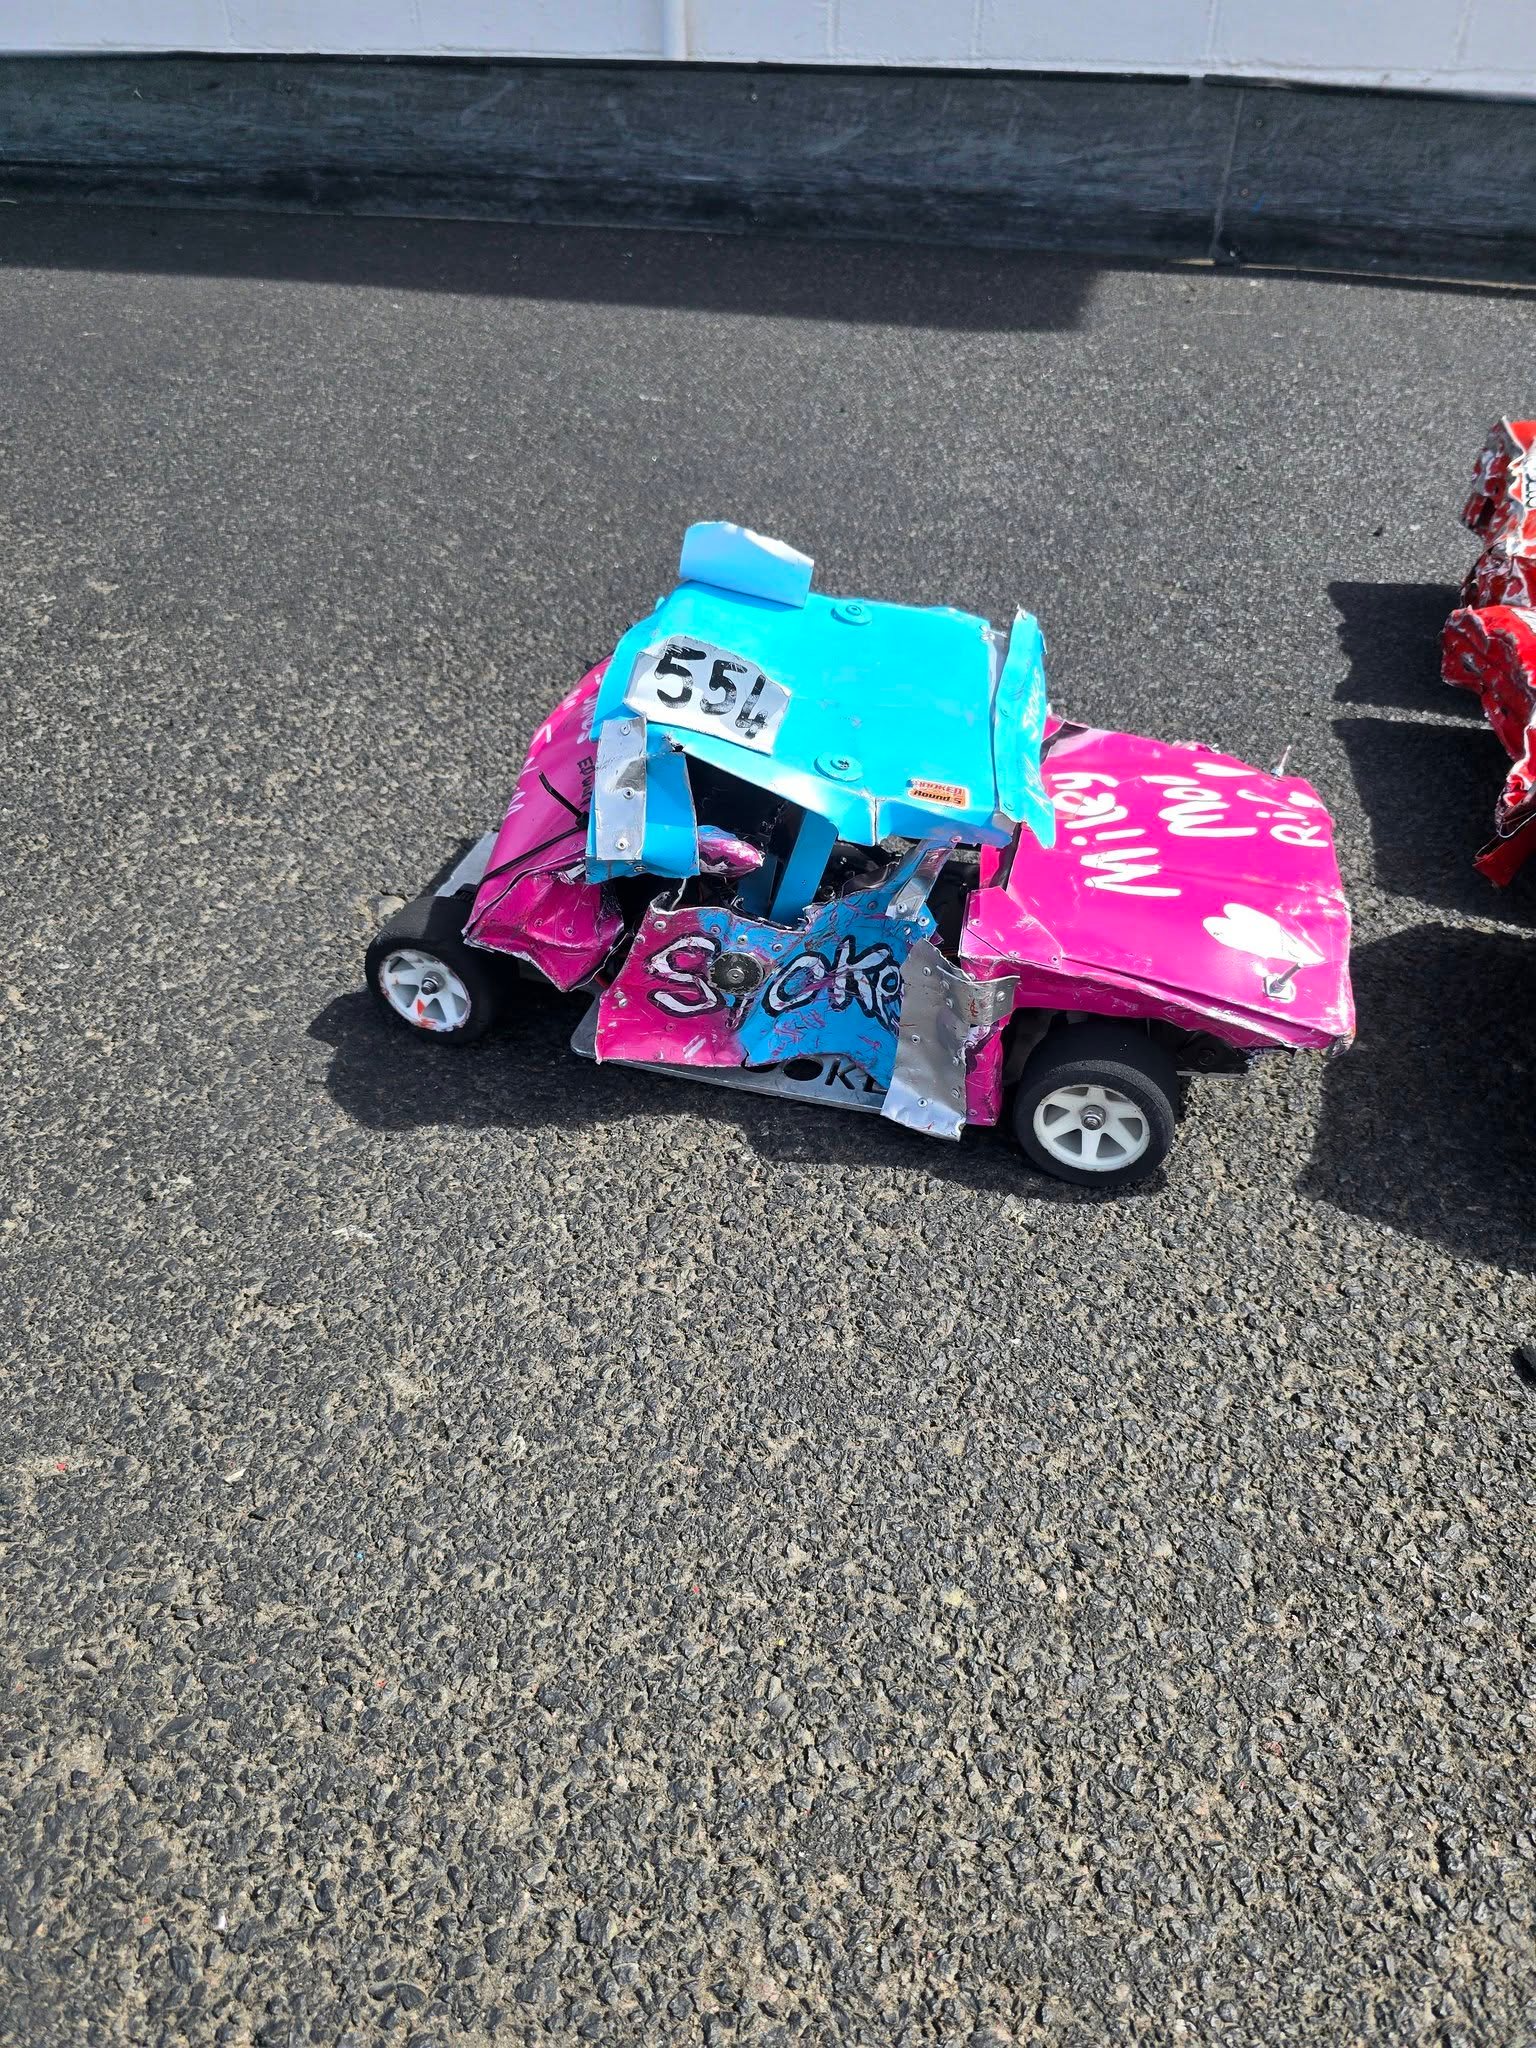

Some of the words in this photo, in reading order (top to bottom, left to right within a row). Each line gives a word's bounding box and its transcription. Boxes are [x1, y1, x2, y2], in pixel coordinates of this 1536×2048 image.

[654, 643, 767, 740] 554
[913, 788, 951, 802] Round
[1050, 772, 1181, 897] Miley
